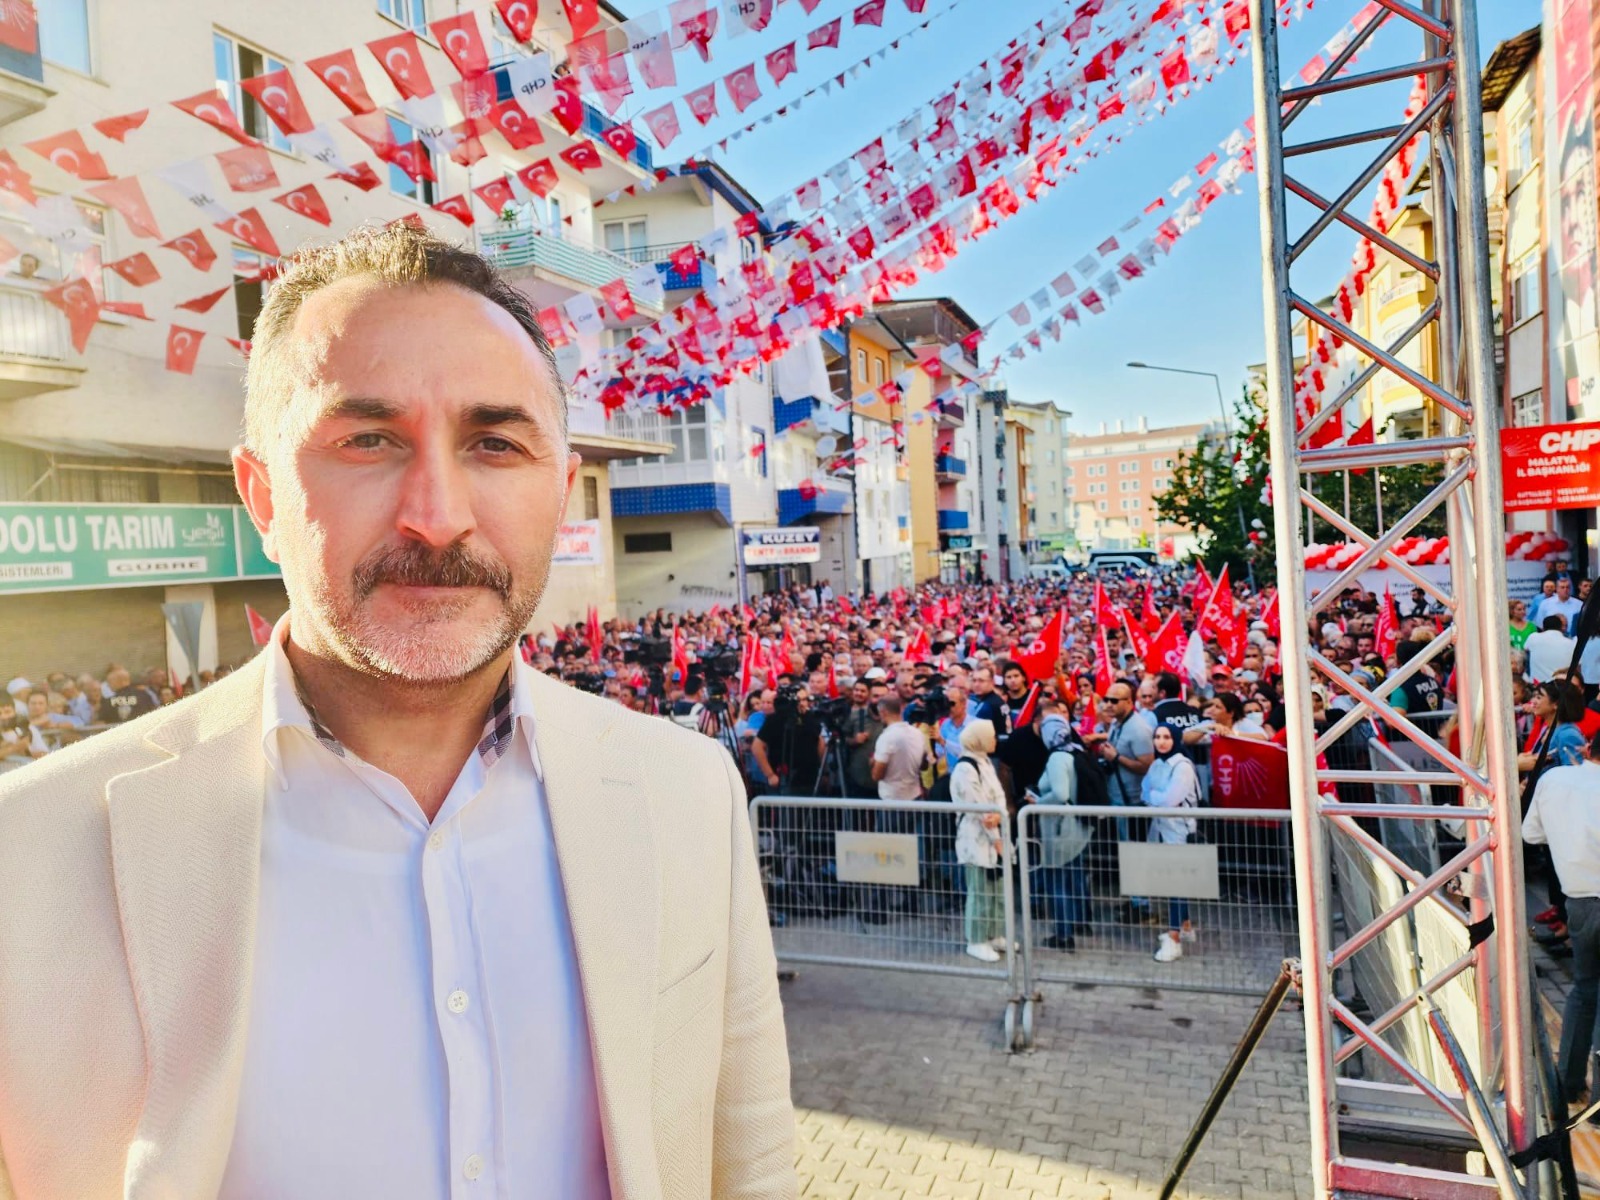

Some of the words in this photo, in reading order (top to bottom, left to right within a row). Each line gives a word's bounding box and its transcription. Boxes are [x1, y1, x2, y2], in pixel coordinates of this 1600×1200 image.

[1539, 428, 1600, 454] CHP
[1527, 461, 1591, 478] BAŞKANLIĞI
[1528, 455, 1577, 468] MALATYA
[85, 515, 175, 550] TARIM
[762, 532, 816, 544] KUZEY
[1218, 754, 1234, 796] CHP
